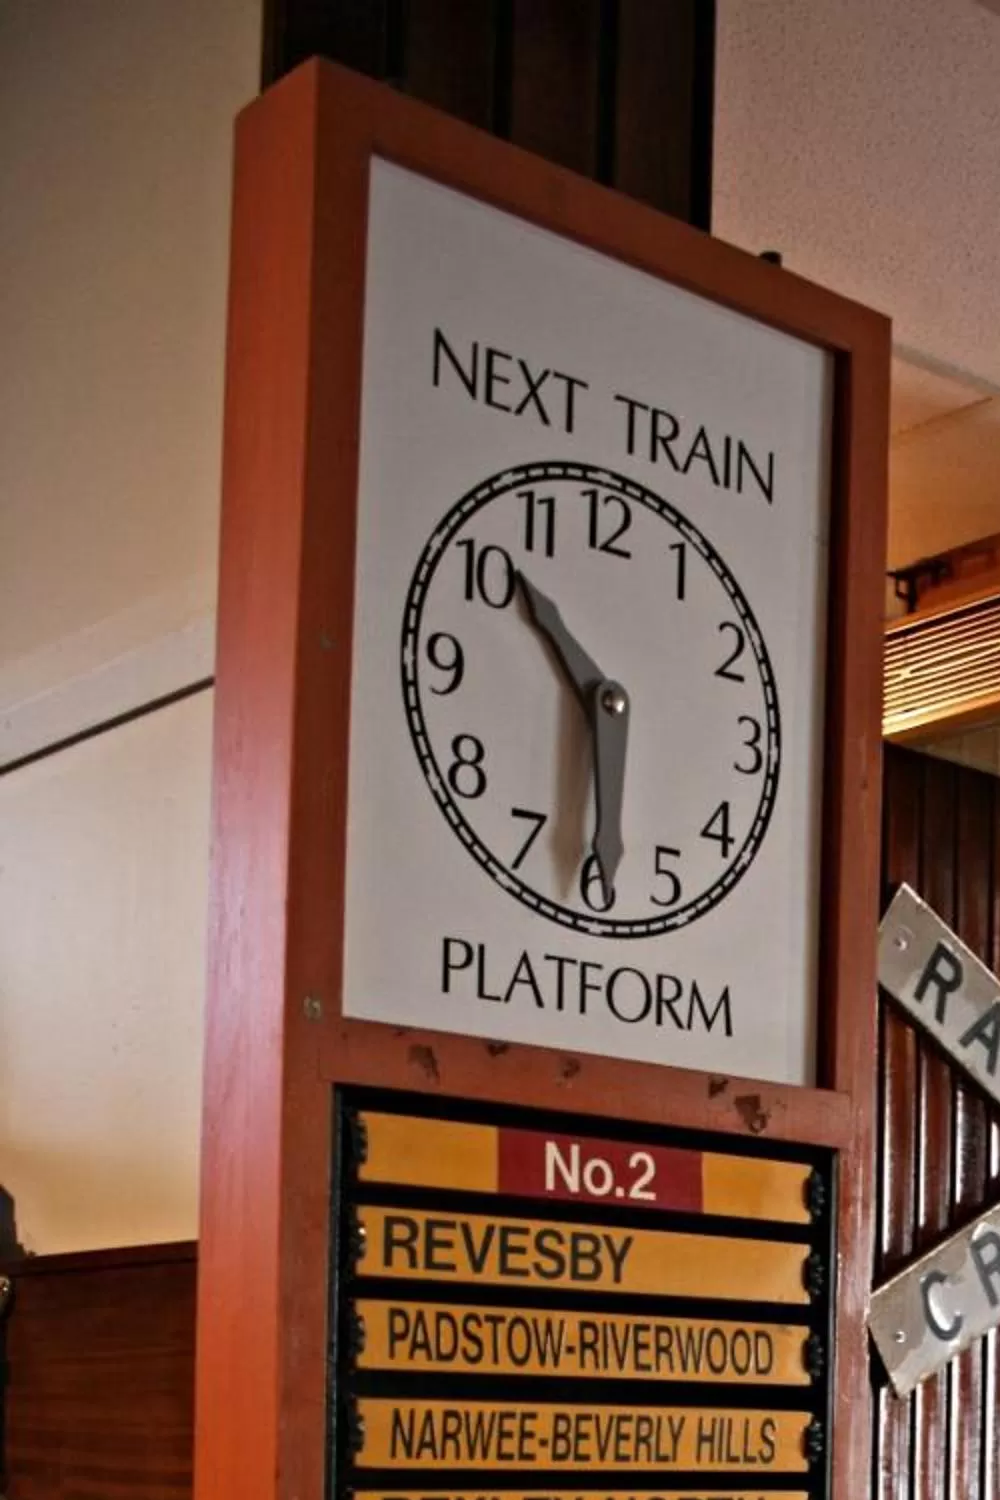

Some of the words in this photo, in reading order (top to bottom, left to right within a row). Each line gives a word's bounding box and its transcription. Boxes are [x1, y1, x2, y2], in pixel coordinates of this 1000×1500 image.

[433, 327, 589, 434] NEXT
[613, 394, 775, 505] TRAIN
[516, 490, 556, 559] 11
[580, 488, 633, 560] 12
[456, 538, 518, 610] 10
[668, 542, 687, 601] 1
[425, 632, 465, 696] 9
[713, 621, 747, 683] 2
[446, 734, 488, 799] 8
[733, 715, 764, 775] 3
[510, 807, 549, 869] 7
[700, 800, 736, 859] 4
[578, 850, 617, 913] 6
[649, 845, 682, 907] 5
[440, 936, 734, 1038] PLATFORM
[543, 1140, 658, 1201] No.2
[382, 1214, 635, 1285] REVESBY
[387, 1307, 774, 1376] PADSTOW-RIVERWOOD
[389, 1407, 687, 1464] NARWEE-BEVERLY
[694, 1416, 777, 1465] HILLS
